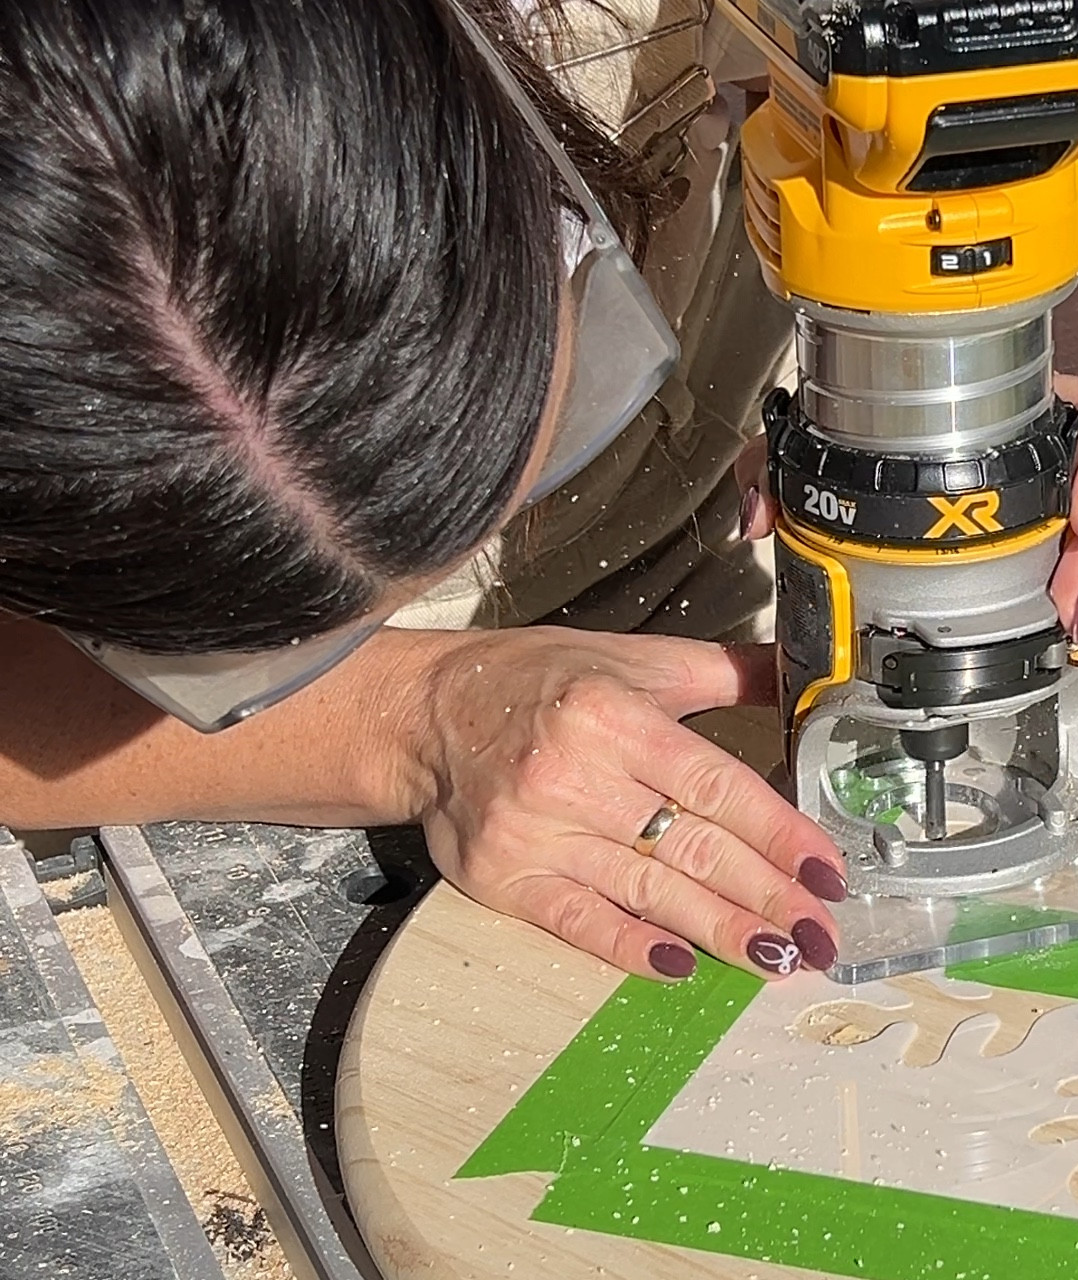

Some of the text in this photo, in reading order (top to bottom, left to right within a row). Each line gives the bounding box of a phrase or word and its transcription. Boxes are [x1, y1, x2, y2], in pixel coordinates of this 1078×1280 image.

[941, 250, 992, 270] 2 1
[803, 483, 857, 526] 20V
[923, 491, 1004, 539] XR
